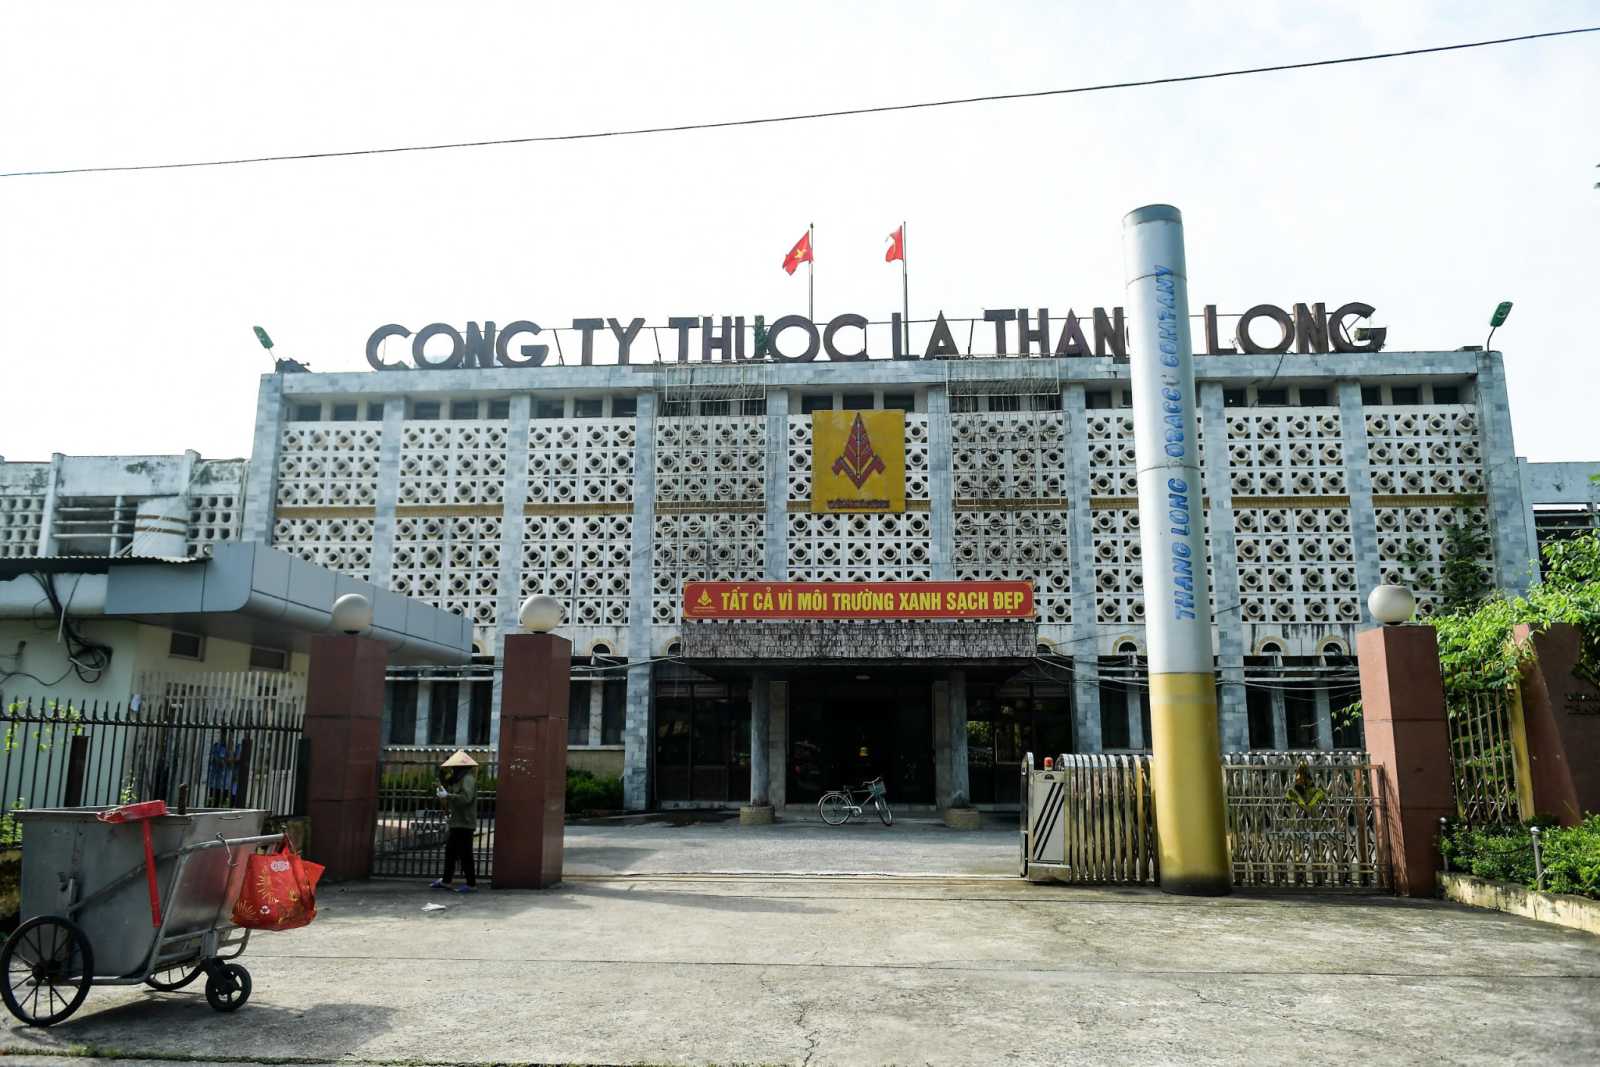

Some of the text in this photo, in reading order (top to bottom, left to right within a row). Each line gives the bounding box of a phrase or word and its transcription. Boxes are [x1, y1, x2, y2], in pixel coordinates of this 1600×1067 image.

[366, 302, 1387, 371] CONG TY THUOC LA THAN LONG
[1154, 264, 1196, 620] THANG LONG OBACC COMPANY
[721, 586, 1025, 614] TẤT CẢ VÌ MÔI TRƯỜNG XANH SẠCH ĐẸP
[1270, 832, 1346, 841] THANG LONG
